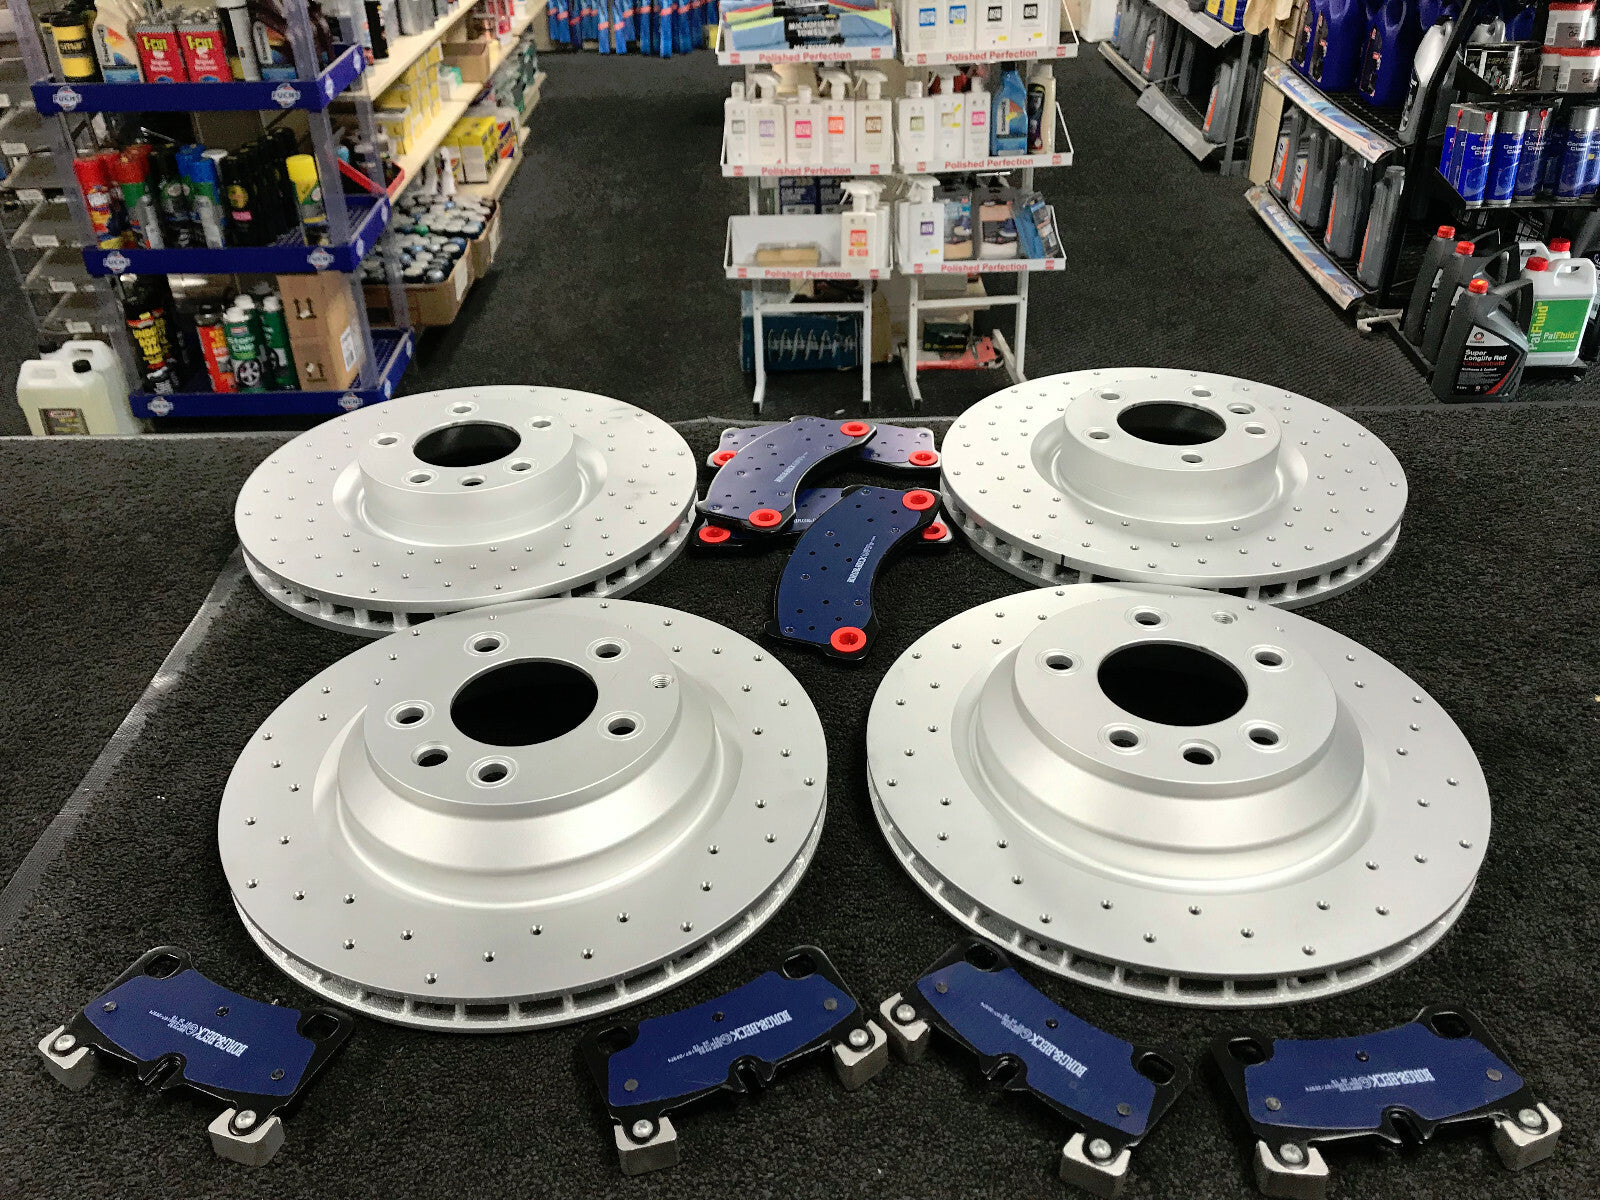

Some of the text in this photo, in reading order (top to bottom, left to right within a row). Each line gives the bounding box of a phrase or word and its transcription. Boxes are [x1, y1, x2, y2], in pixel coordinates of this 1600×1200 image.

[759, 52, 852, 62] Polished Perfection
[946, 49, 1037, 61] Polished Perfection
[945, 158, 1034, 169] Polished Perfection
[761, 165, 851, 175] Polished Perfection
[941, 262, 1028, 273] Polished Perfection
[764, 269, 852, 279] Polished Perfection
[1529, 305, 1549, 350] PalFluid
[1544, 331, 1575, 340] PalFluid
[1464, 354, 1492, 362] Longlife
[1465, 349, 1487, 357] Super
[732, 1009, 793, 1042] BORG&BECK
[195, 1025, 249, 1058] BORG&BECK
[1028, 1033, 1088, 1078] BORG&BECK
[1370, 1068, 1436, 1088] BORG&BECK
